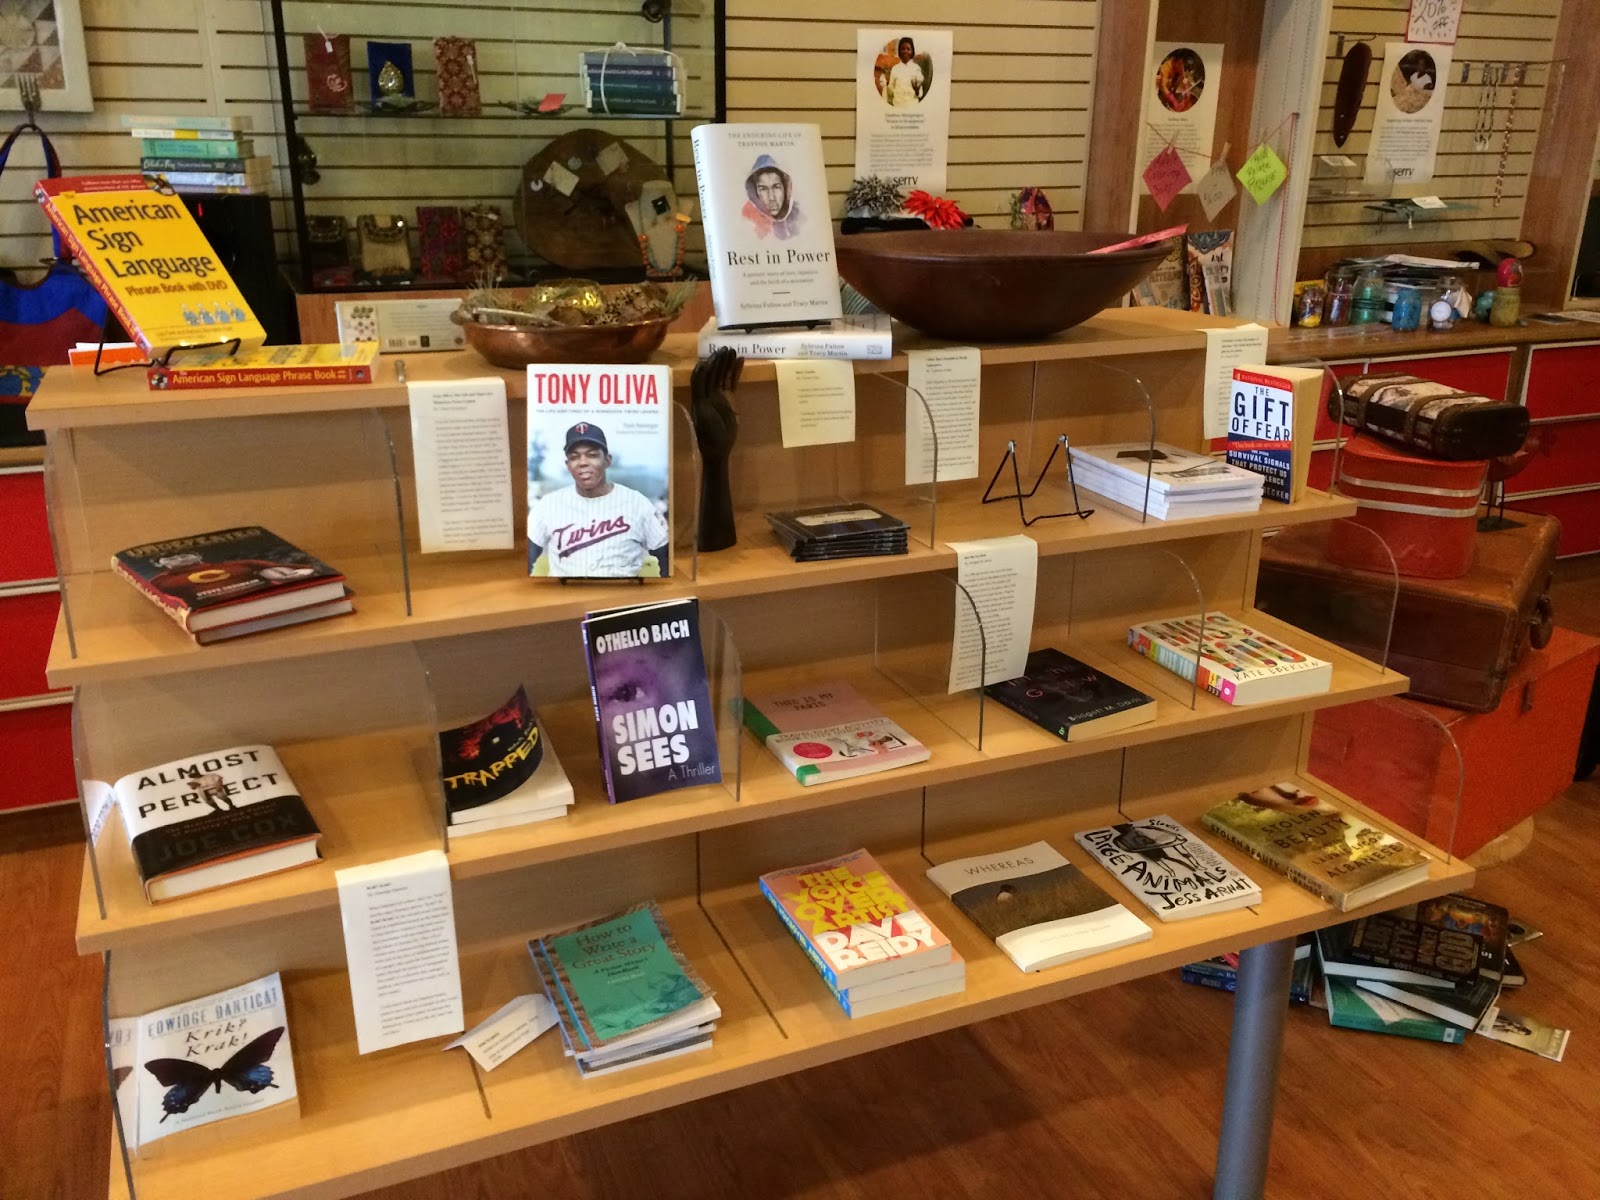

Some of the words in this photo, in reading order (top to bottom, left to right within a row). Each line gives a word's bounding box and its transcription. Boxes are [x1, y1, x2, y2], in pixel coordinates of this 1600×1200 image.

[72, 199, 181, 226] American
[87, 227, 144, 254] Sign
[105, 254, 216, 280] Language
[727, 250, 760, 266] Rest
[766, 250, 781, 264] in
[787, 248, 830, 264] Power
[125, 284, 160, 297] Phrase
[162, 282, 186, 294] Book
[188, 281, 206, 292] with
[208, 280, 228, 292] DVD
[737, 344, 748, 354] in
[752, 344, 787, 354] Power
[172, 372, 215, 385] American
[216, 372, 236, 385] Sign
[238, 371, 281, 384] Language
[283, 370, 312, 382] Phrase
[314, 369, 336, 380] Book
[534, 373, 592, 404] TONY
[600, 373, 658, 405] OLIVA
[1255, 386, 1270, 396] THE
[1234, 392, 1290, 426] GIFT
[1232, 417, 1250, 434] OF
[1256, 422, 1290, 442] FEAR
[1228, 450, 1262, 463] SURVIVAL
[1264, 458, 1290, 470] SIGNALS
[1231, 459, 1247, 468] THAT
[1249, 463, 1278, 475] PROTECT
[1279, 470, 1288, 478] US
[552, 515, 631, 551] Twins
[596, 626, 650, 654] OTHELLO
[651, 619, 690, 643] BACH
[1234, 669, 1263, 682] KATE
[612, 700, 698, 744] SIMON
[444, 726, 539, 790] TRAPPED
[618, 734, 690, 776] SEES
[138, 750, 260, 791] ALMOST
[668, 769, 678, 781] A
[680, 763, 716, 778] Thriller
[138, 772, 278, 818] PERFECT
[1261, 809, 1322, 834] STOLEN
[1273, 816, 1350, 850] BEAUTY
[1210, 824, 1244, 850] STOLEN
[1245, 845, 1280, 869] BEAUTY
[964, 856, 1034, 876] WHEREAS
[1326, 845, 1402, 878] ALBANESE
[576, 929, 613, 946] How
[616, 924, 632, 934] to
[814, 910, 930, 950] DAVE
[572, 954, 616, 969] Great
[616, 942, 656, 959] Story
[582, 940, 626, 955] Write
[629, 936, 638, 944] a
[148, 1008, 207, 1036] EDWIDGE
[216, 987, 279, 1019] DANTICAT
[184, 1018, 248, 1044] Krik?
[185, 1032, 248, 1058] Krak!
